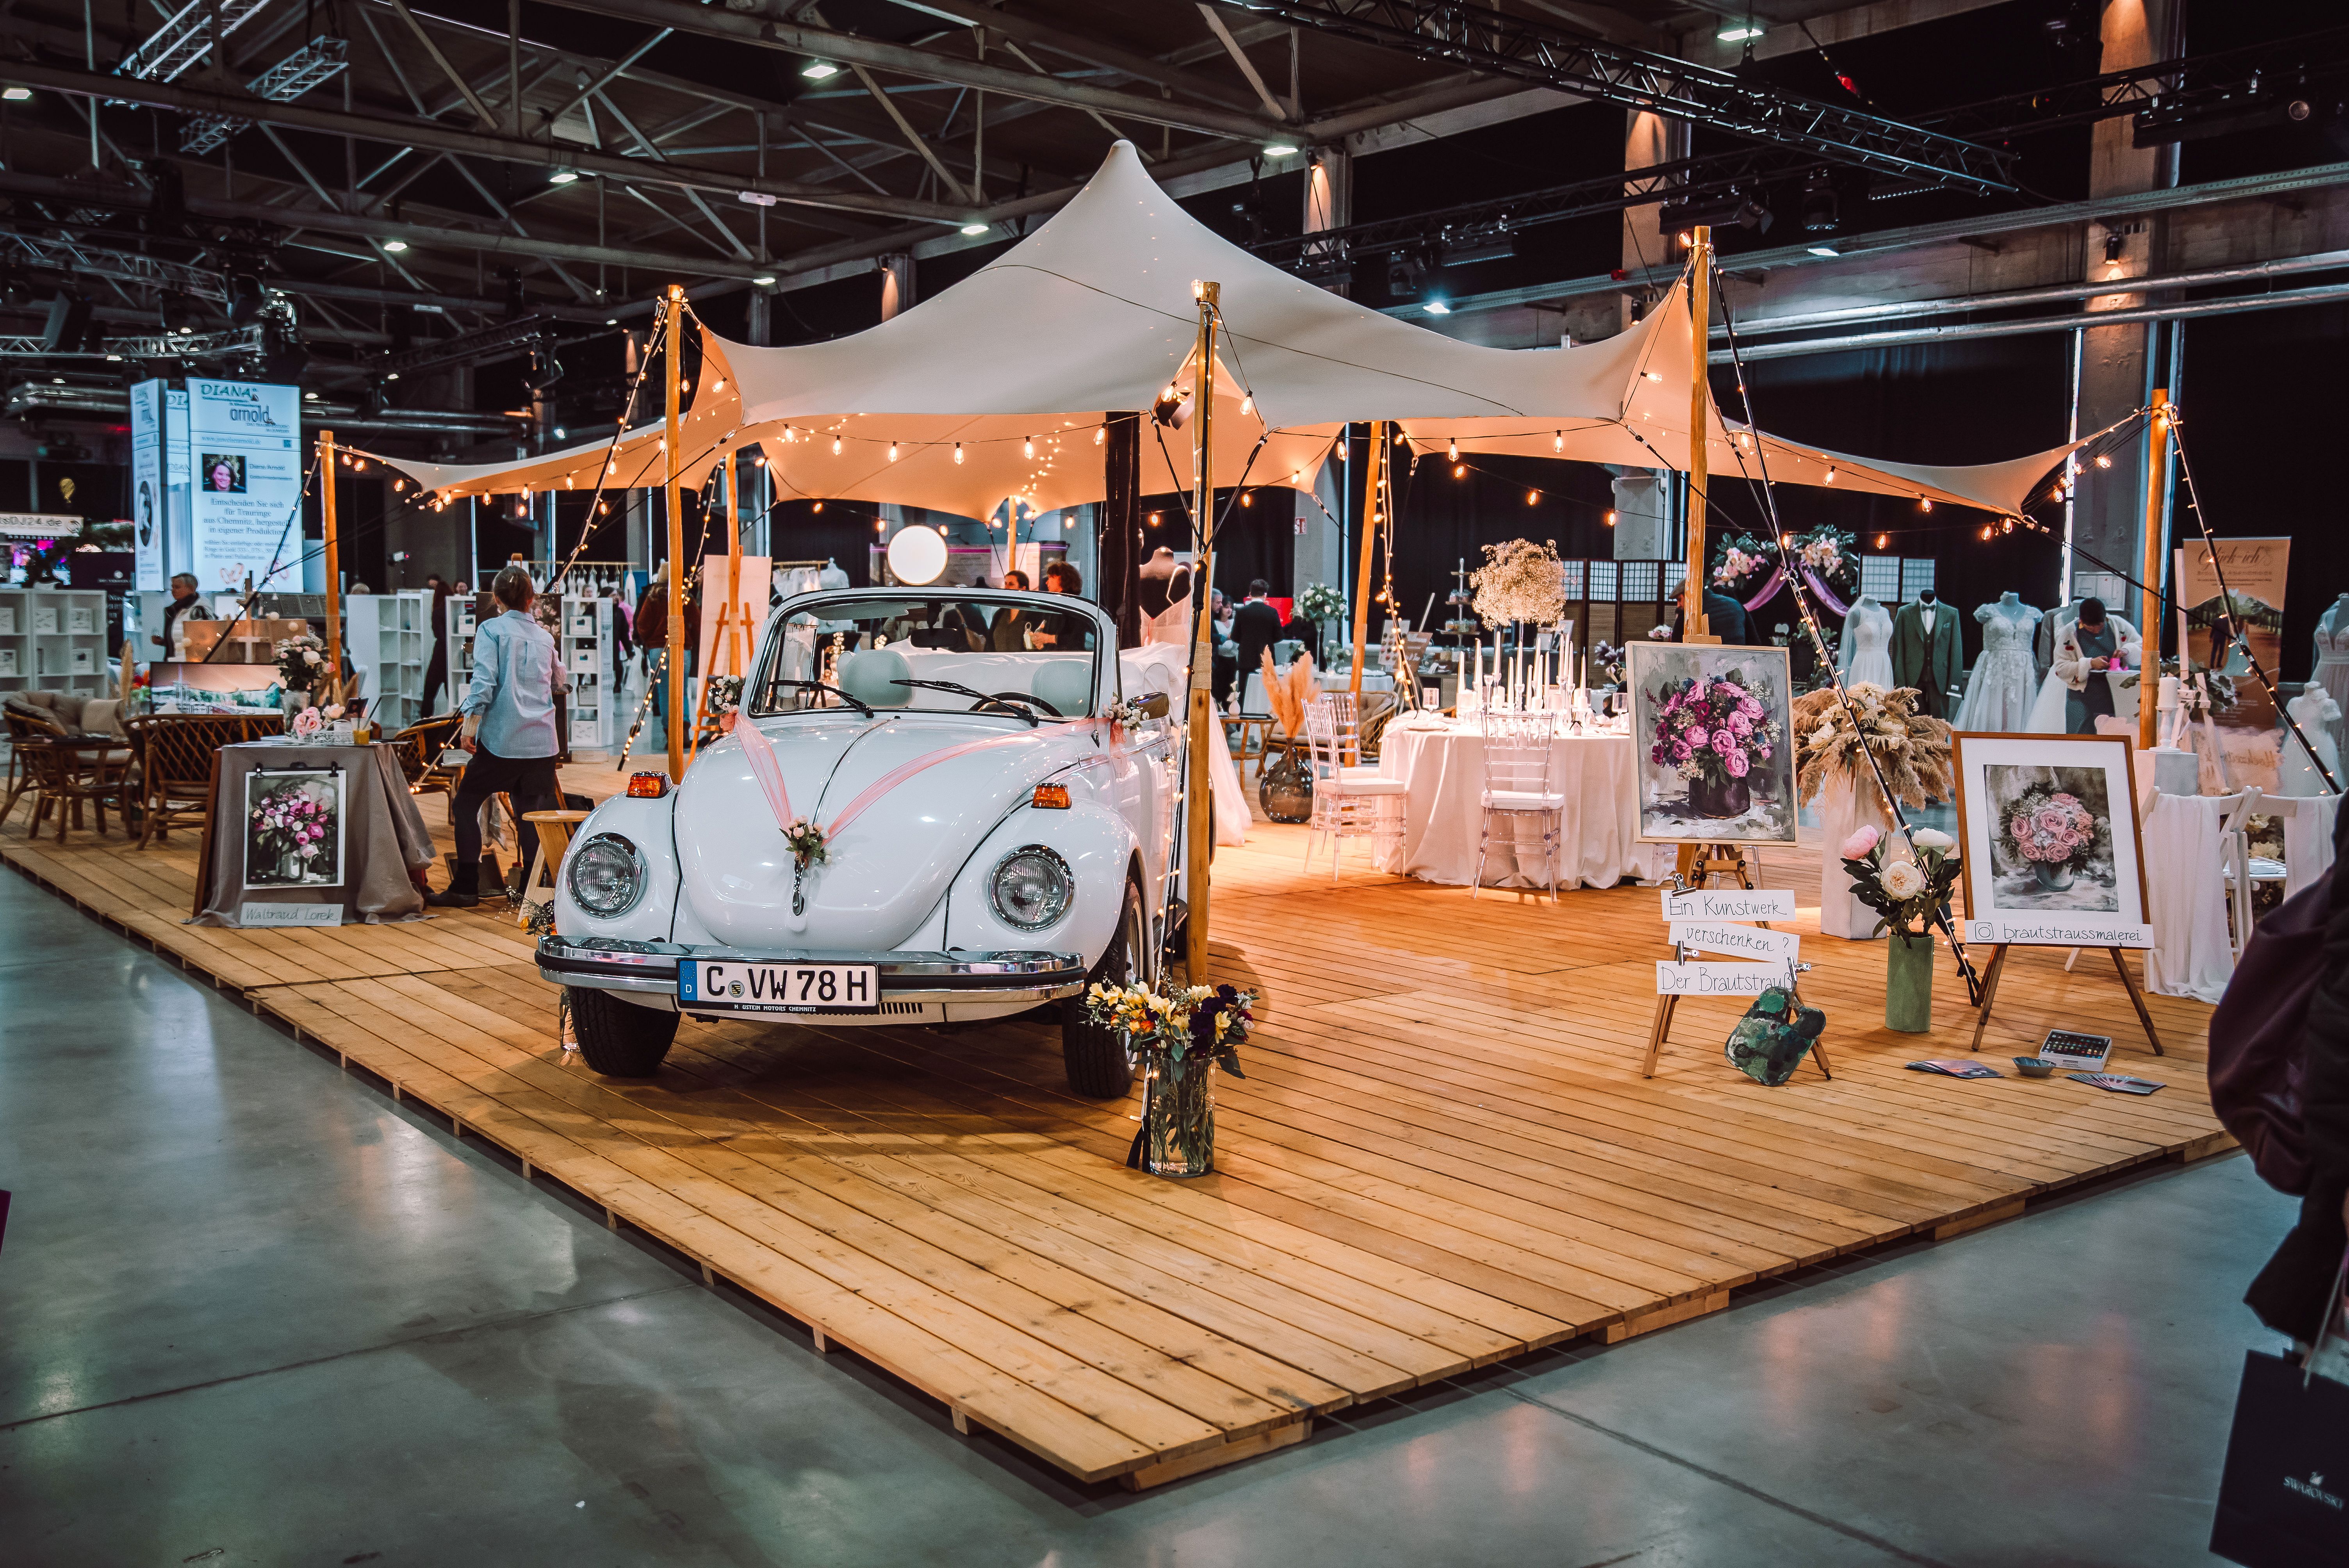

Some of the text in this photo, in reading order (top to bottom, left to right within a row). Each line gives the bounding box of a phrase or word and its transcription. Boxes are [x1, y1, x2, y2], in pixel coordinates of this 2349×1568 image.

[200, 384, 252, 398] DIANA
[230, 404, 270, 423] arnold
[210, 497, 255, 506] Entscheiden
[238, 509, 272, 518] Trauringe
[246, 908, 338, 921] Waltraud Lorek
[1669, 895, 1787, 916] Ein Kunstwerk
[1686, 927, 1789, 953] verschenken ?
[2003, 923, 2143, 941] brautstraussmalerei
[706, 966, 867, 1001] C VW 78 H
[1661, 966, 1793, 992] Der Brautstrauß
[685, 984, 692, 993] D
[2283, 1477, 2343, 1509] SWAROVSKI
